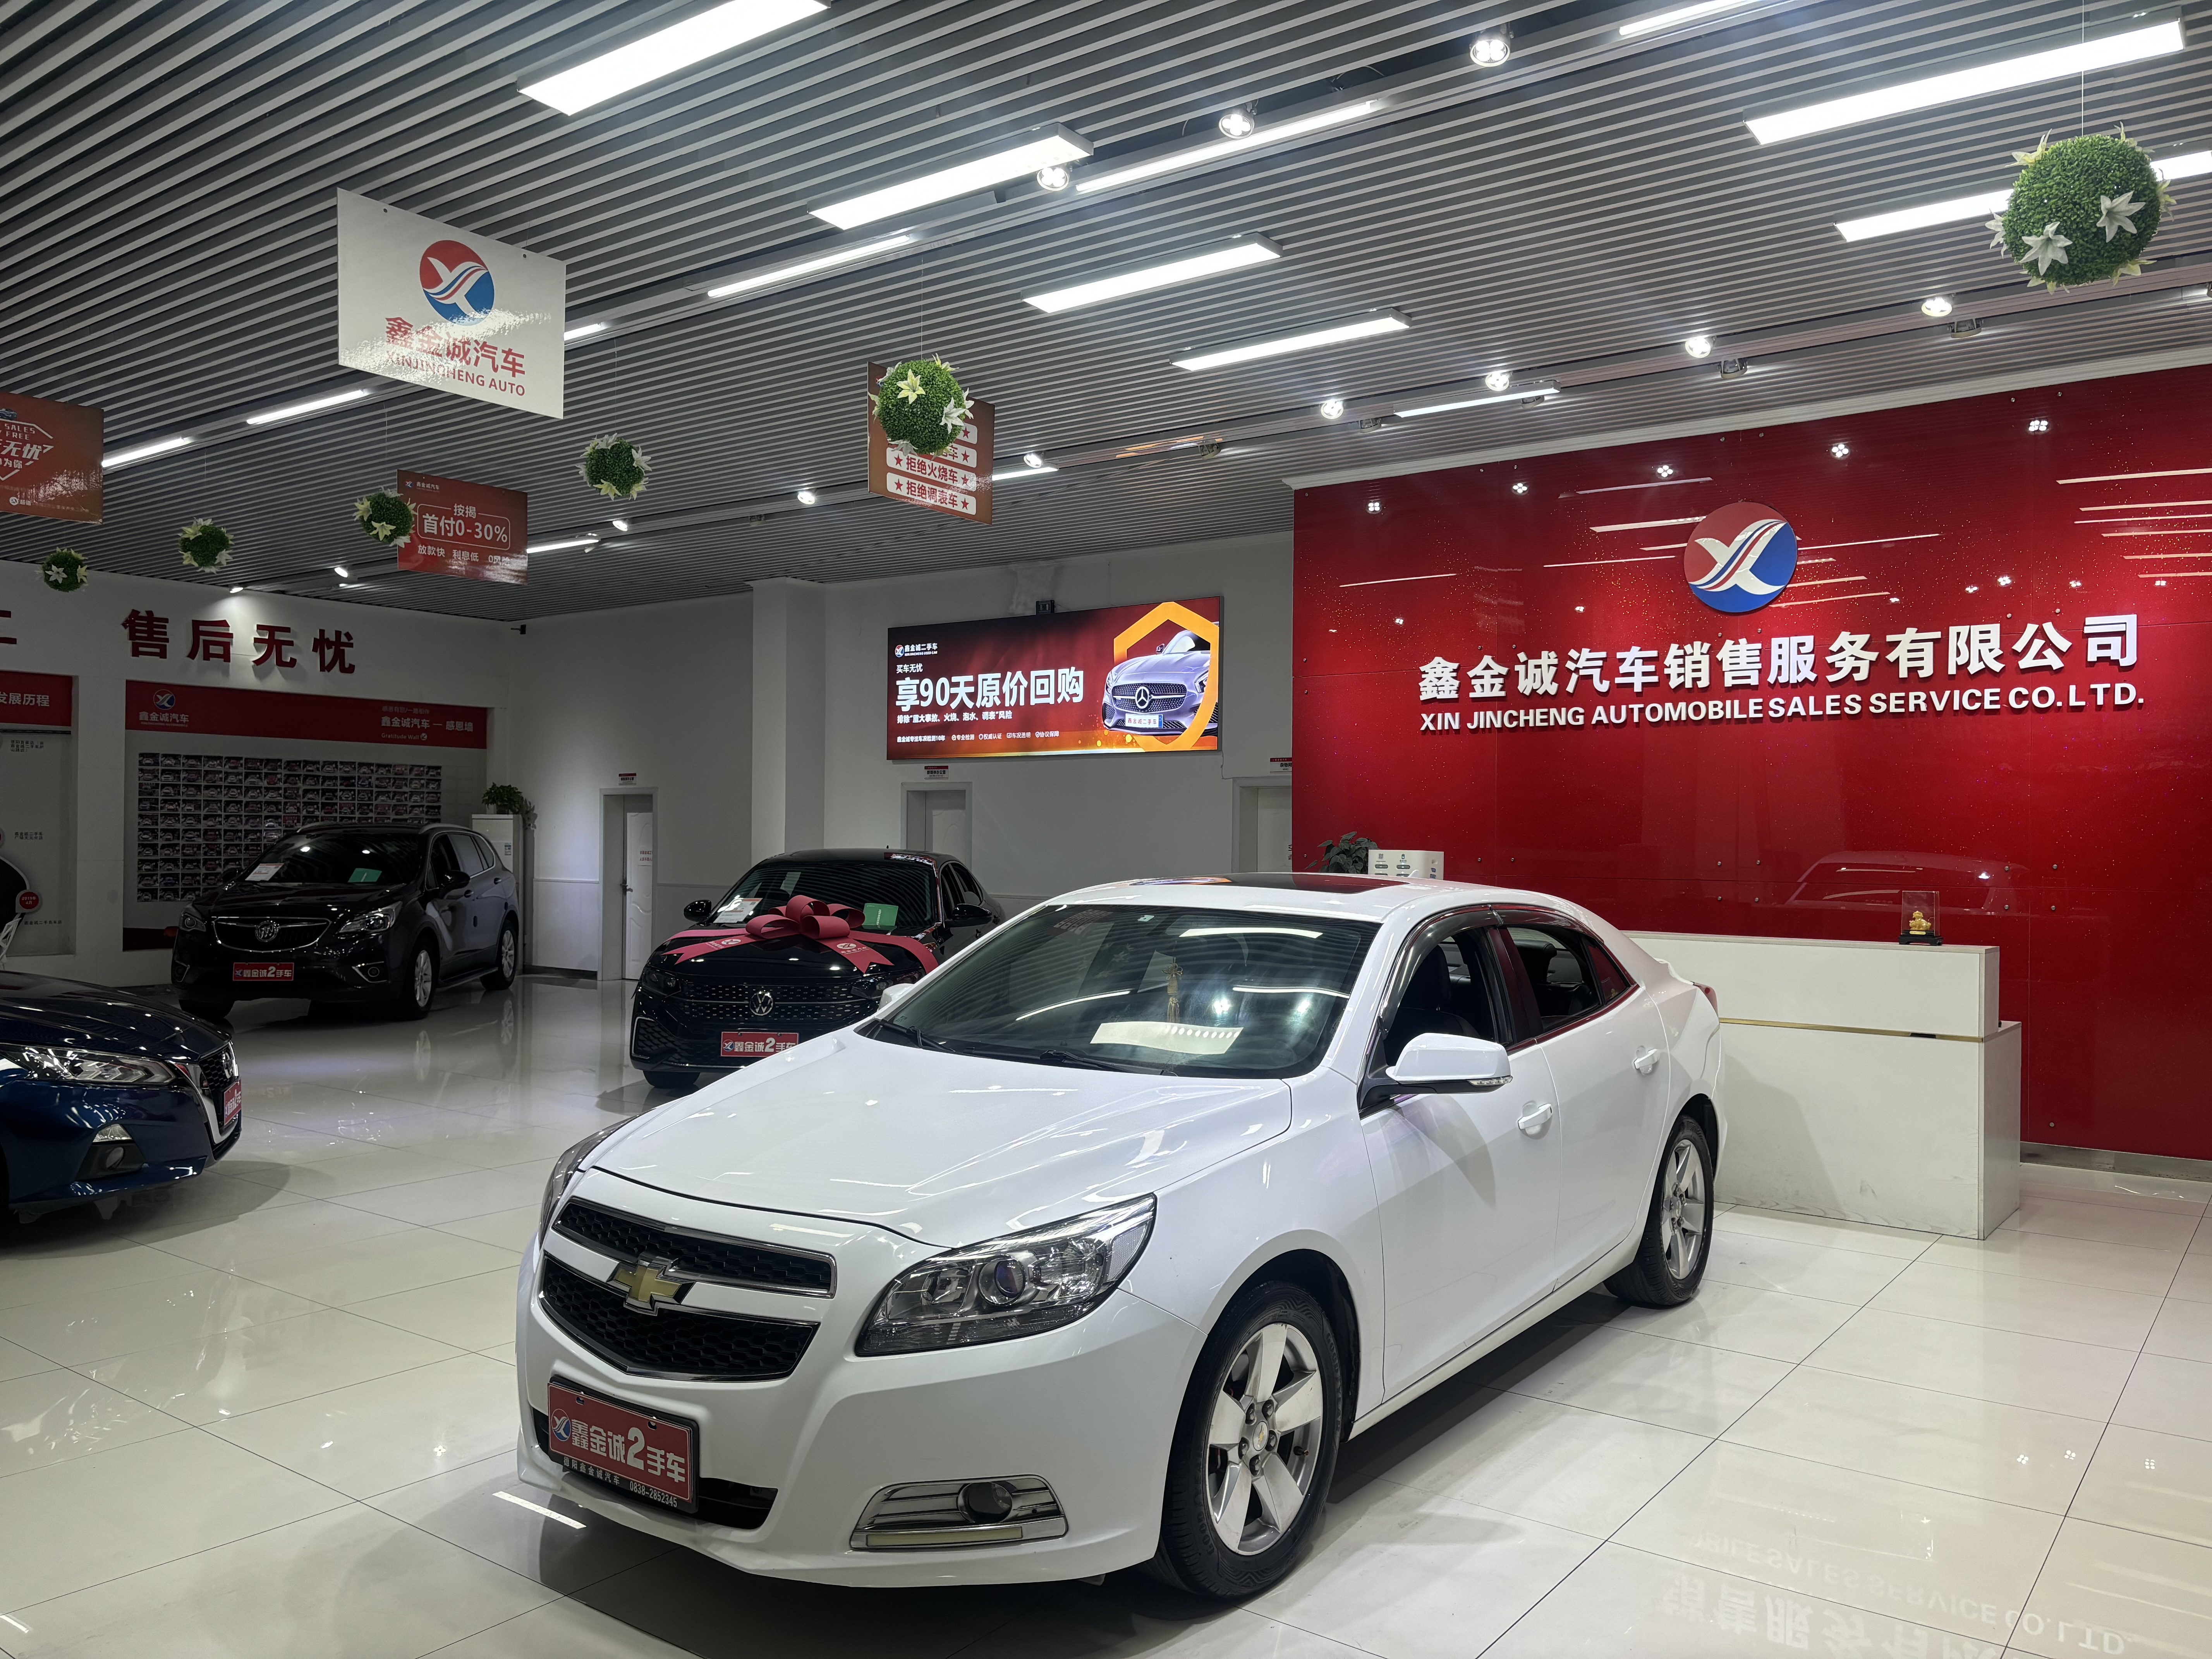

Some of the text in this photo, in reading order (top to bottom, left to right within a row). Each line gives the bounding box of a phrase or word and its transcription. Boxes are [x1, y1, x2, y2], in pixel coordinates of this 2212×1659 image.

[385, 317, 525, 378] 鑫金诚汽车
[489, 378, 525, 396] AUTO
[5, 423, 35, 433] SALES
[906, 457, 958, 484] 拒绝火烧车
[907, 480, 958, 508] 拒绝调表车
[453, 503, 476, 519] 按揭
[422, 514, 507, 543] 首付0-30%
[418, 544, 445, 557] 放款快
[452, 550, 479, 562] 利息低
[121, 609, 356, 674] 售后无忧
[896, 663, 923, 673] 买车无忧
[1419, 613, 2138, 701] 鑫金诚汽车销售服务有限公司
[895, 666, 1084, 712] 享90天原价回购
[139, 711, 189, 723] 鑫金诚汽车
[1420, 712, 1460, 731] XIN
[1467, 707, 1585, 729] JINCHENG
[1591, 698, 1764, 725] AUTOMOBILE
[1768, 693, 1862, 718] SALES
[1869, 688, 2001, 714] SERVICE
[243, 966, 292, 977] 鑫金诚2手车
[571, 1419, 685, 1482] 鑫金诚2手车
[563, 1456, 620, 1486] 德阳鑫金诚汽车
[630, 1481, 677, 1508] 0838-2852345
